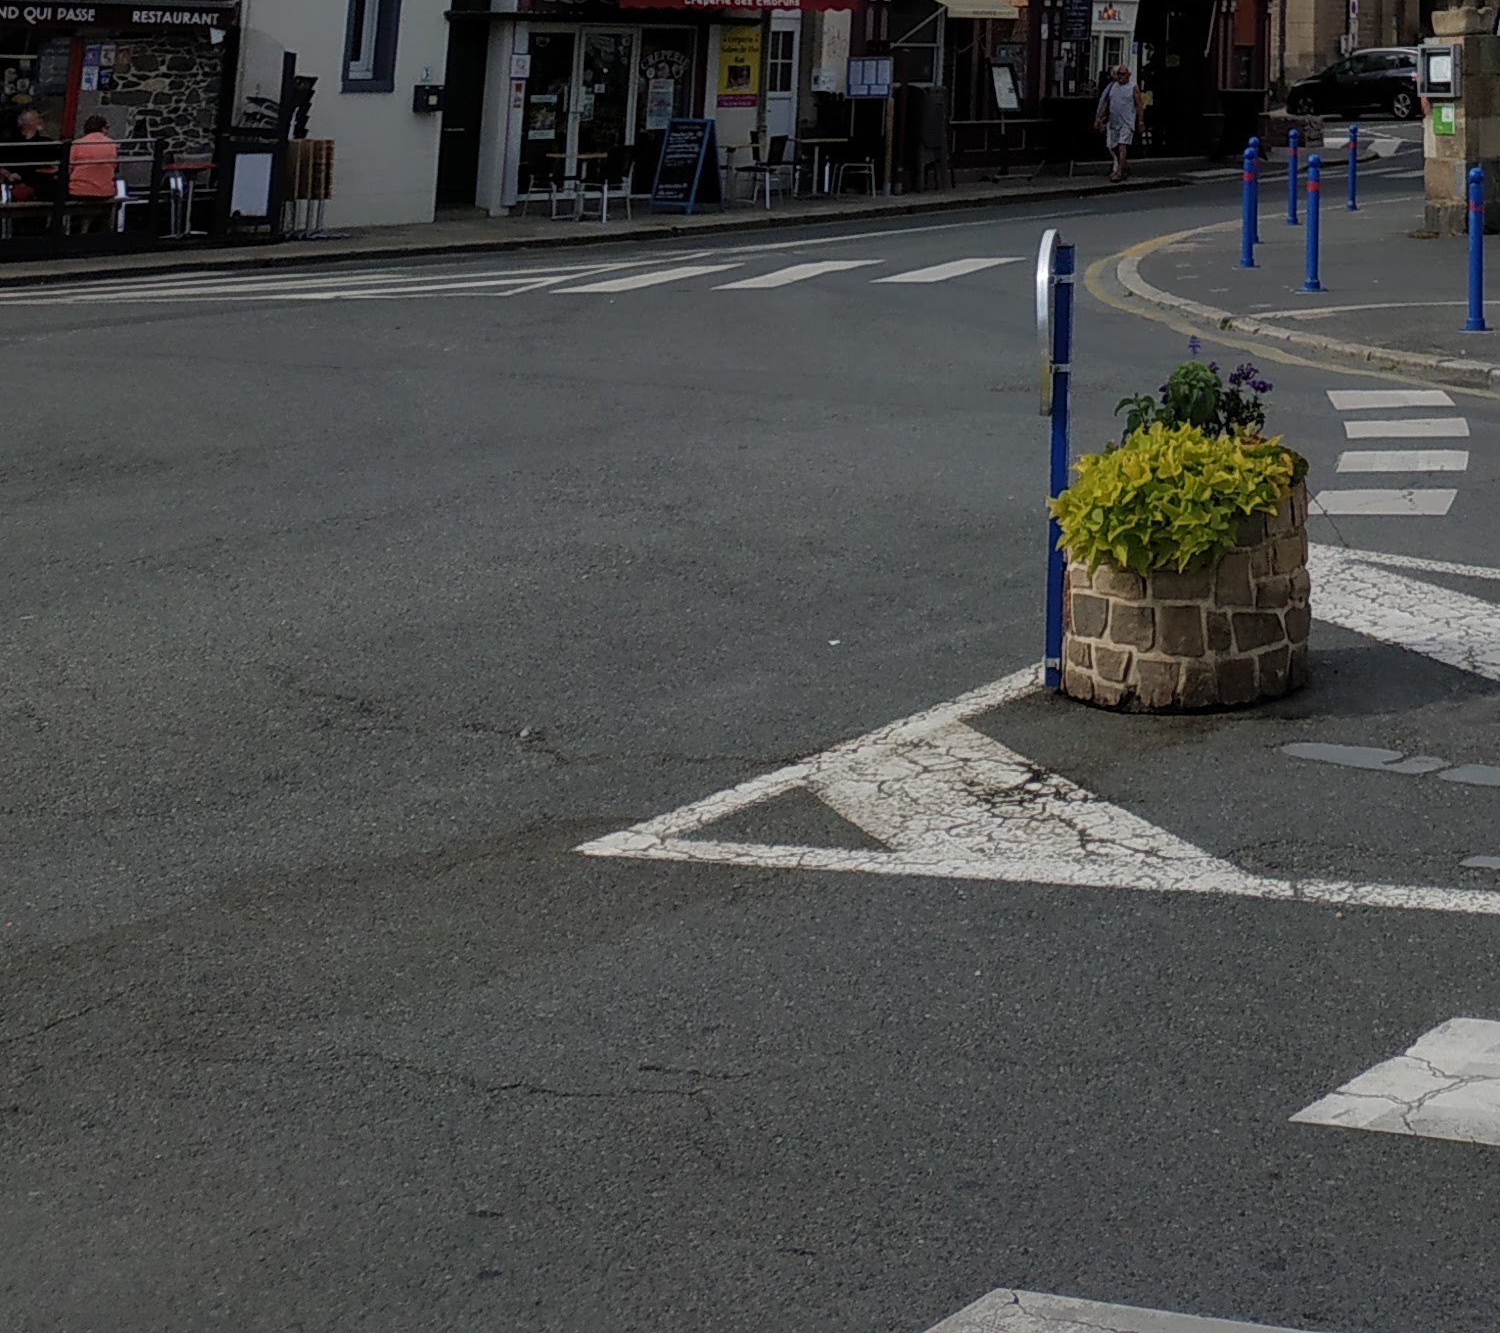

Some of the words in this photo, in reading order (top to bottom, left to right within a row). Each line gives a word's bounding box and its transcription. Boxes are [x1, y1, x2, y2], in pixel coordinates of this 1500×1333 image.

[23, 6, 52, 24] QUI
[57, 7, 96, 21] PASSE
[132, 10, 220, 25] RESTAURANT
